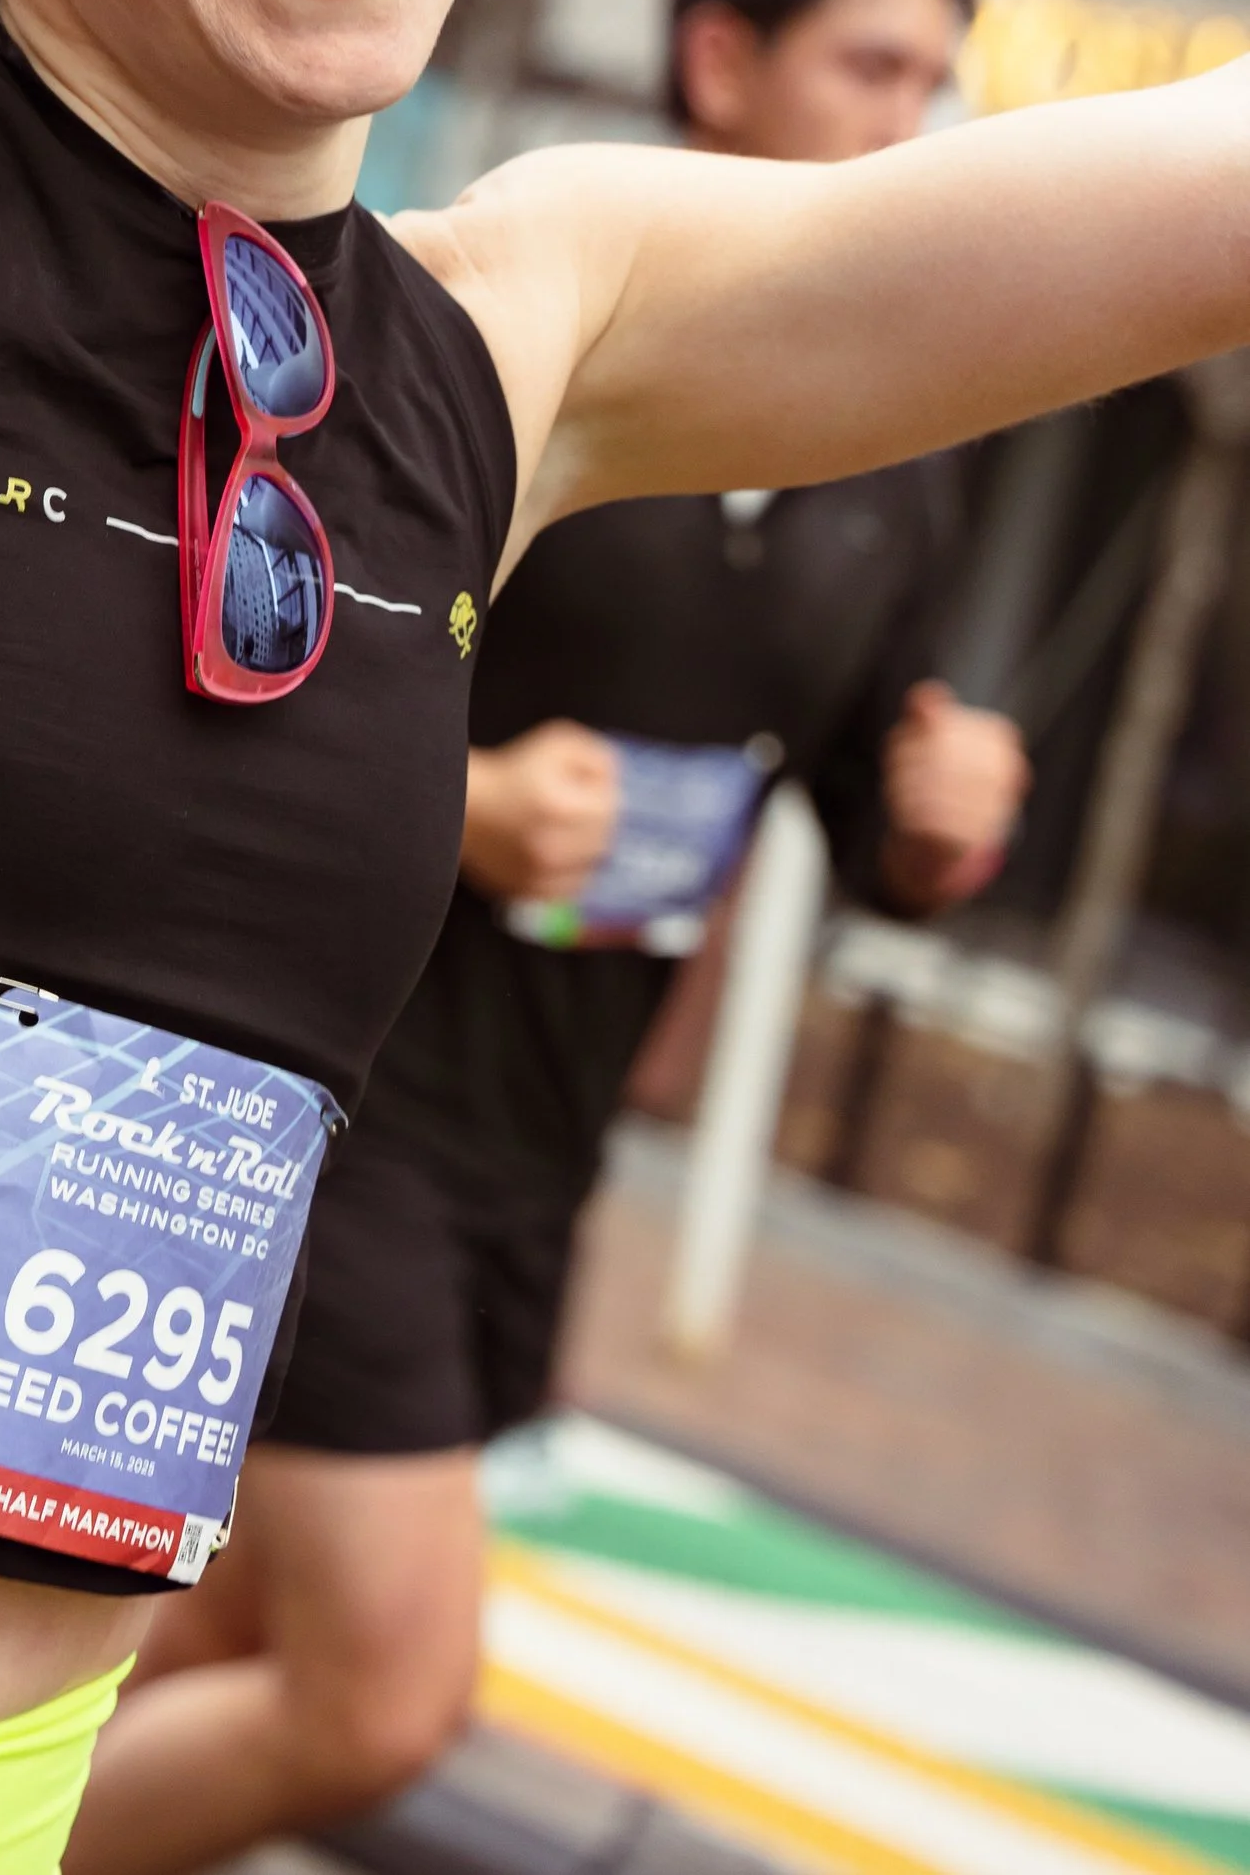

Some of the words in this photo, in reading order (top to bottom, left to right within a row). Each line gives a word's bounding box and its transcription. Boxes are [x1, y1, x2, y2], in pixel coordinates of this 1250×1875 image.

[179, 1073, 215, 1111] ST.
[217, 1087, 278, 1131] JUDE
[50, 1142, 191, 1203] RUNNING
[197, 1186, 276, 1230] SERIES
[51, 1175, 236, 1251] WASHINGTON
[241, 1234, 269, 1261] DC
[4, 1248, 254, 1406] 6295
[60, 1437, 107, 1465] MARCH
[126, 1455, 156, 1477] 2025
[94, 1391, 240, 1467] COFFEE!
[59, 1502, 175, 1555] MARATHON
